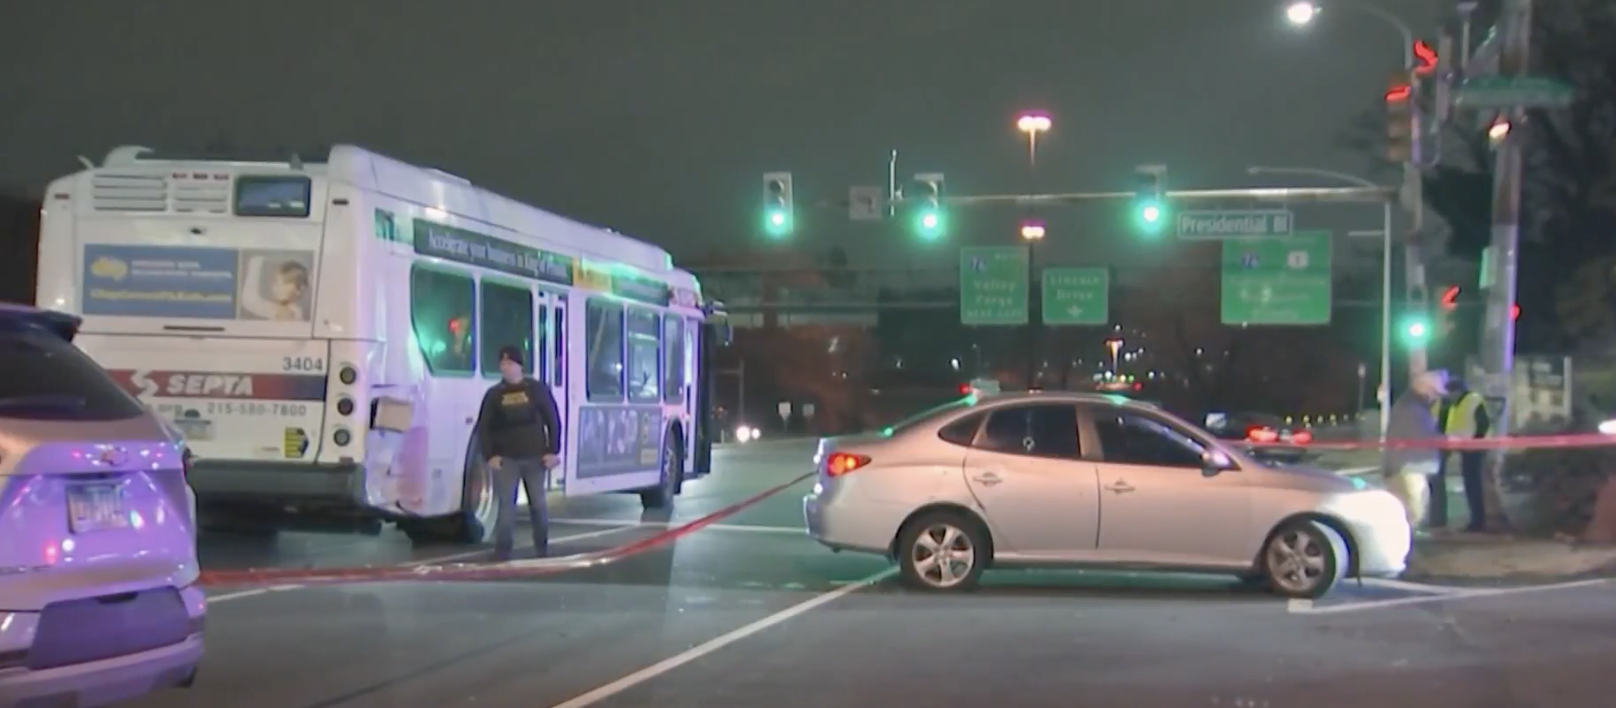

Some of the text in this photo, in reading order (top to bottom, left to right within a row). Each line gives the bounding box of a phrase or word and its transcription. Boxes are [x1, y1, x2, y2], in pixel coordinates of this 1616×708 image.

[1182, 214, 1267, 232] Presidential
[973, 279, 1016, 293] Valley
[976, 294, 1012, 308] Forge
[1057, 289, 1093, 300] Drive
[283, 356, 323, 371] 3404
[167, 373, 254, 396] SEPTA
